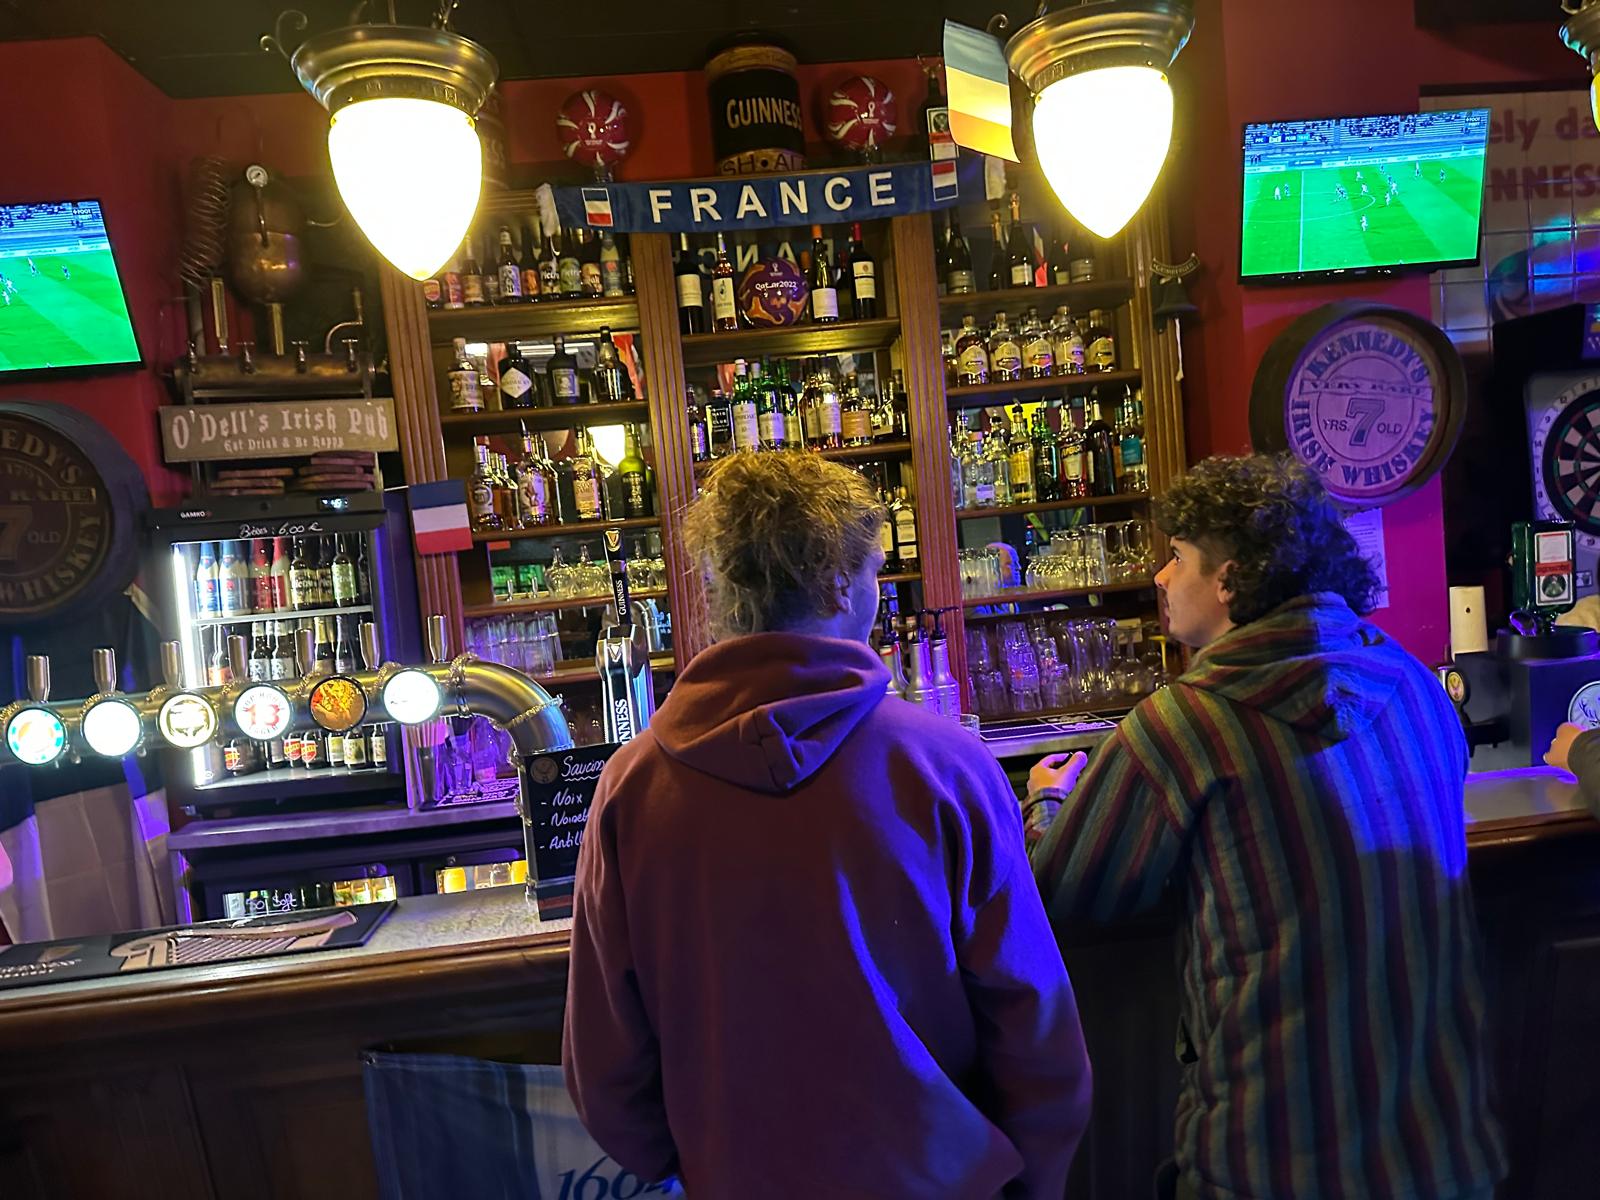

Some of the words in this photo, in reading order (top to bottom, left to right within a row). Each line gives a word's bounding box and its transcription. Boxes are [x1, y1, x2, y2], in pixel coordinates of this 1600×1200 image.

[648, 171, 896, 224] FRANCE
[1491, 164, 1600, 202] NNES
[1306, 330, 1430, 383] KENNEDY'S
[171, 409, 269, 450] O'Dell's
[281, 408, 337, 435] Irish
[349, 405, 389, 441] Pub
[1291, 398, 1337, 474] IRISH
[1345, 397, 1386, 447] 7
[1376, 423, 1402, 435] OLD
[248, 437, 278, 450] Drink
[313, 435, 345, 449] Happy
[278, 521, 306, 536] 6,00
[617, 579, 627, 615] GUINNESS
[247, 703, 281, 728] 13
[552, 787, 583, 807] Noix
